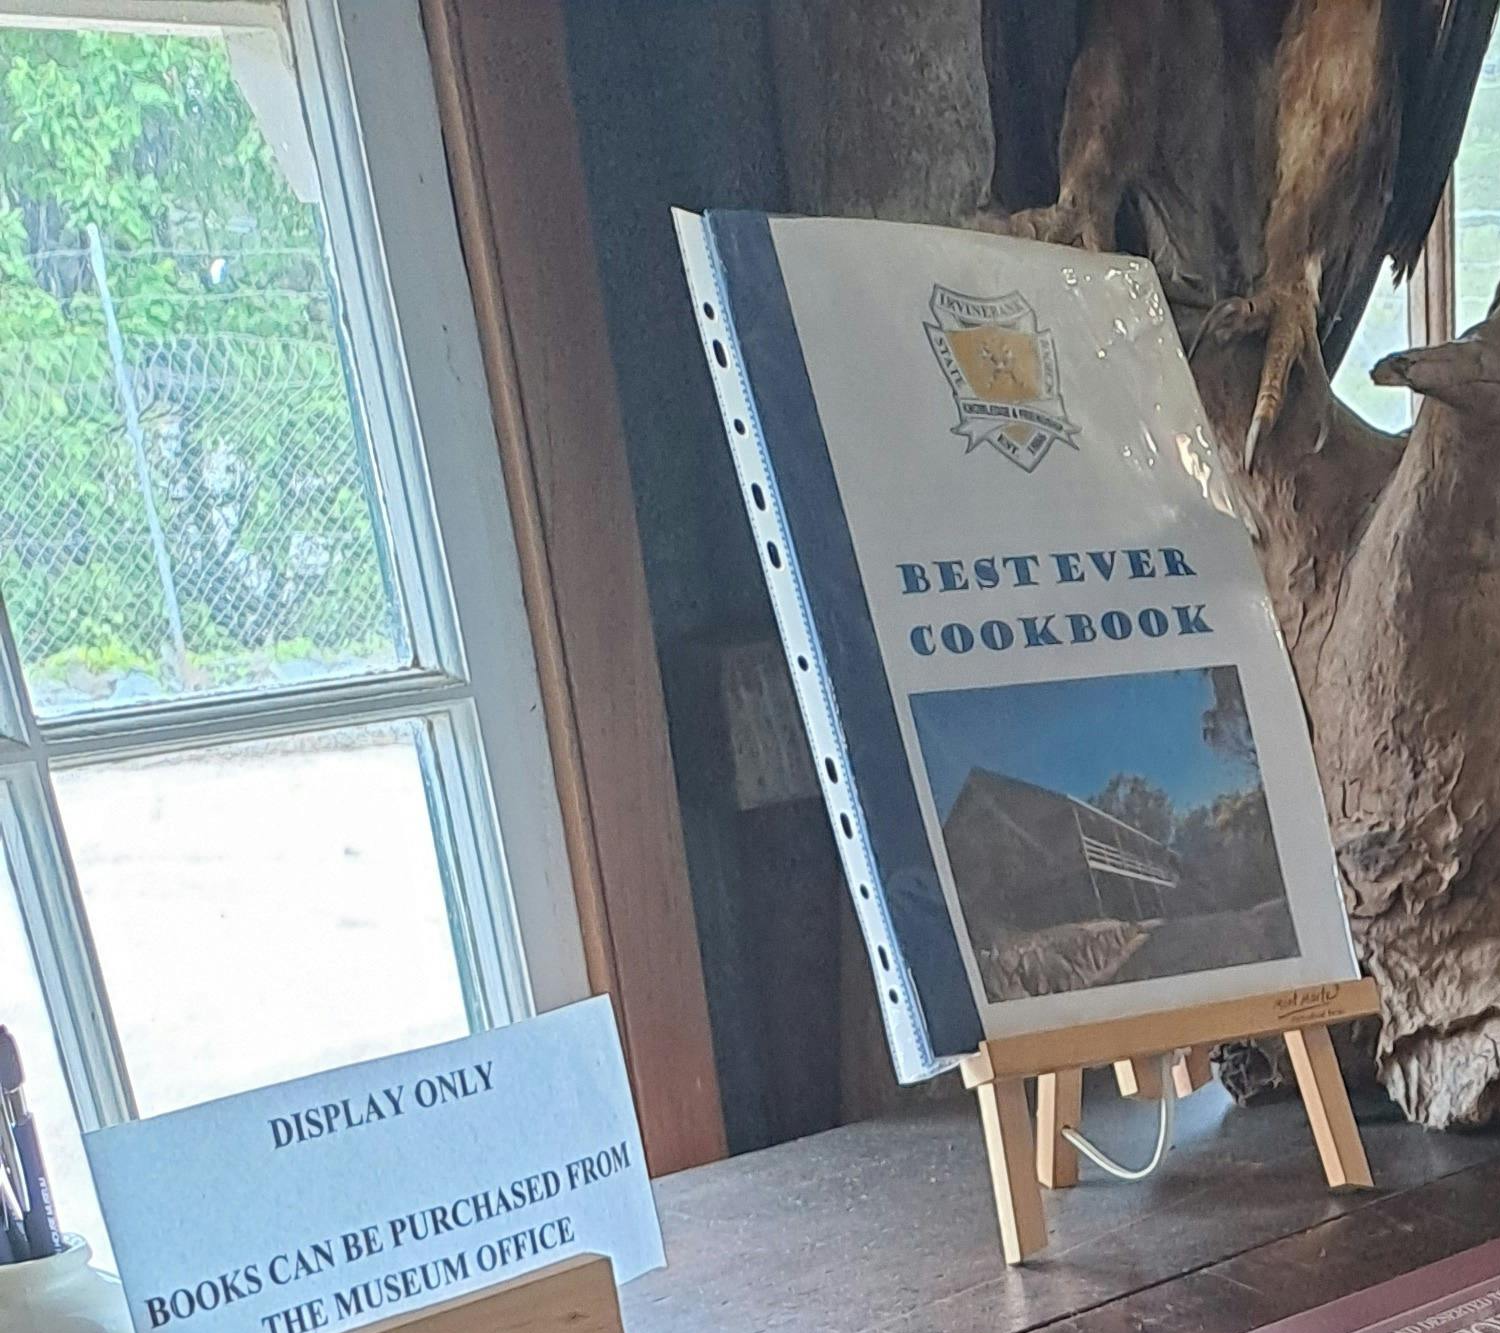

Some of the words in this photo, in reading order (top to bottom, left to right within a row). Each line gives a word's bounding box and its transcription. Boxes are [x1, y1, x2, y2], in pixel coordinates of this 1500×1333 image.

[895, 553, 1041, 596] BEST
[1050, 547, 1198, 584] EVER
[909, 603, 1215, 657] COOKBOOK
[267, 1085, 406, 1150] DISPLAY
[414, 1061, 496, 1109] ONLY
[145, 1263, 264, 1329] BOOKS
[267, 1239, 337, 1286] CAN
[340, 1225, 385, 1264] BE
[388, 1169, 563, 1250] PURCHASED
[564, 1140, 632, 1192] FROM
[335, 1251, 471, 1321] MUSEUM
[476, 1215, 576, 1274] OFFICE
